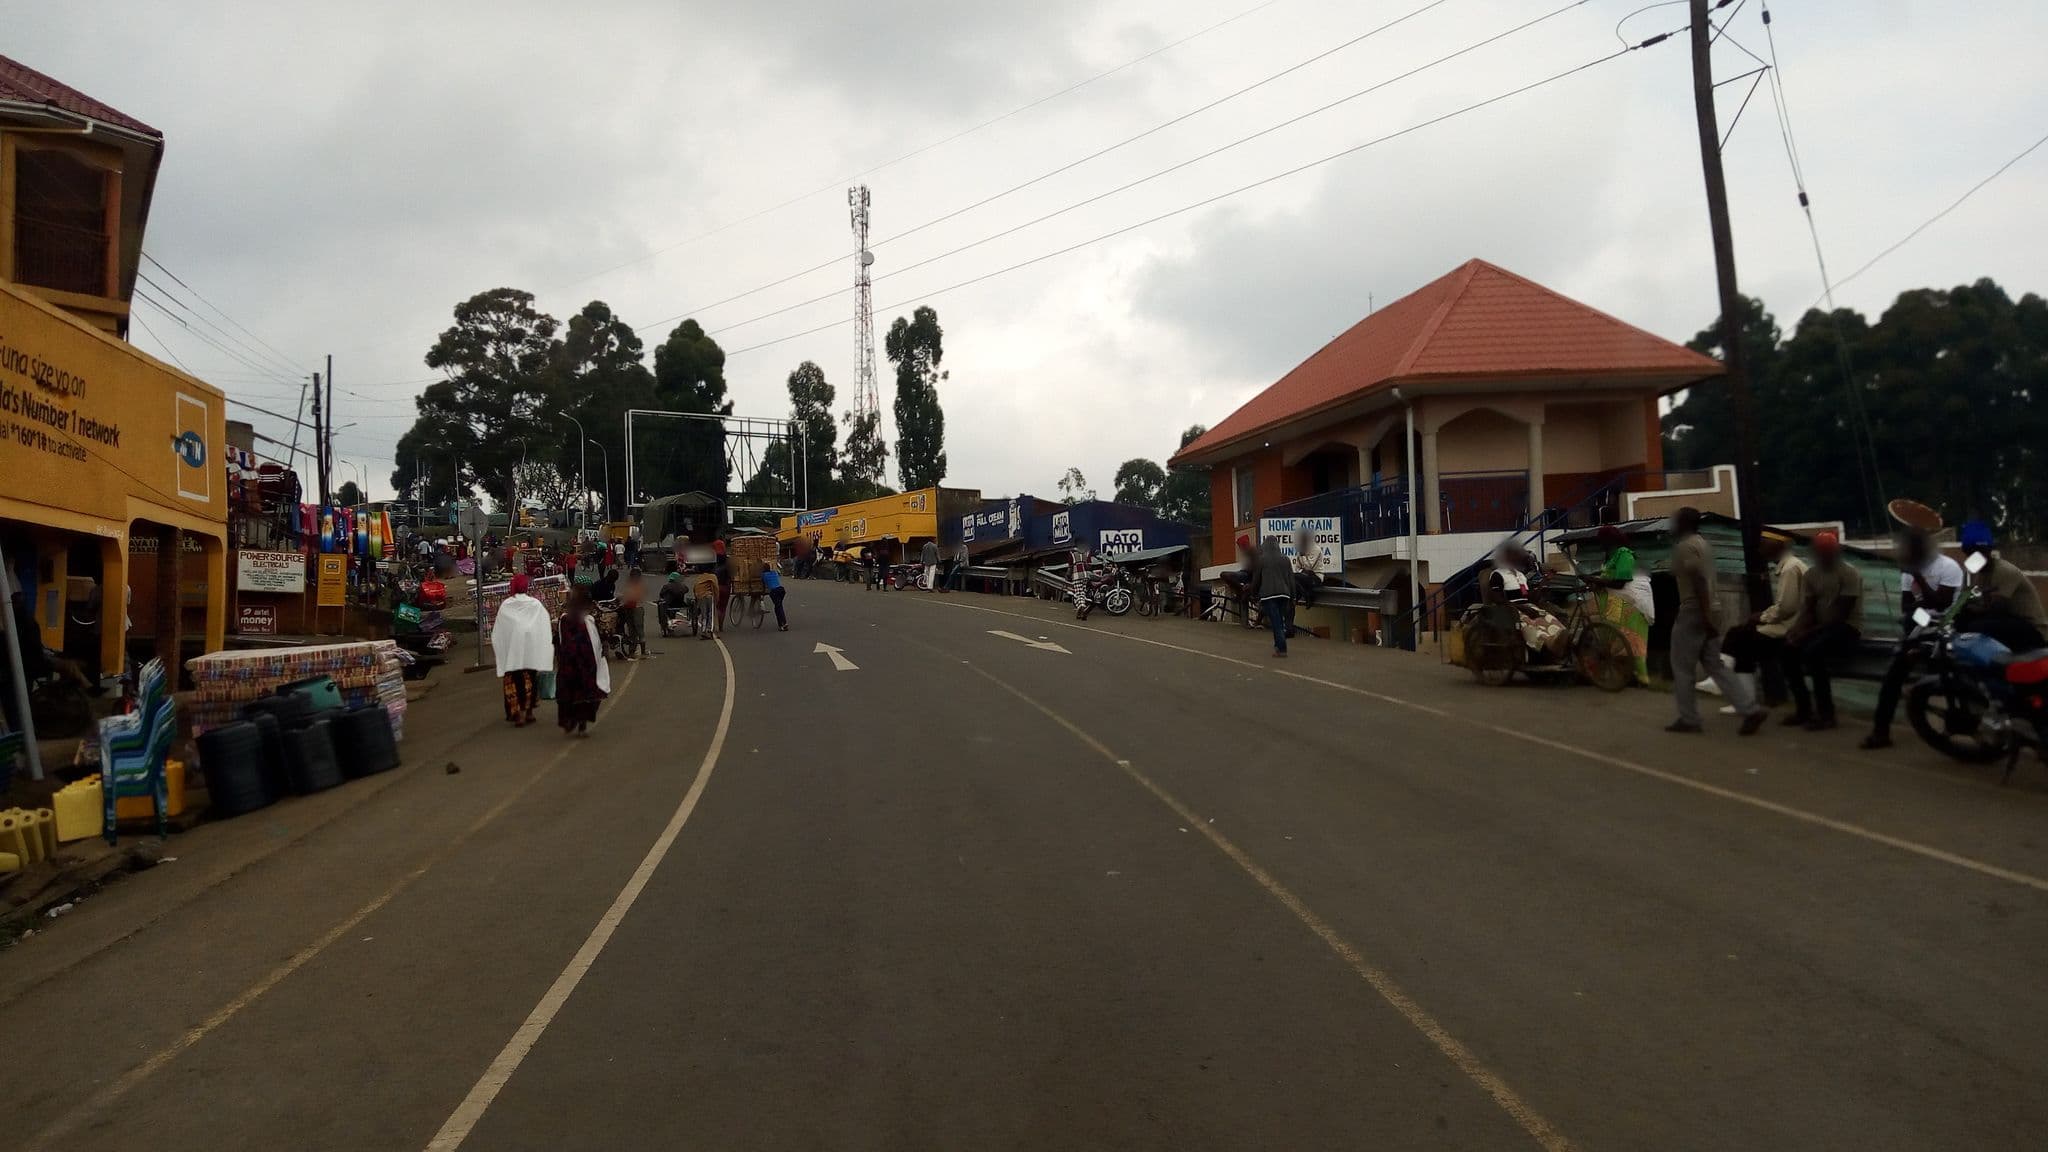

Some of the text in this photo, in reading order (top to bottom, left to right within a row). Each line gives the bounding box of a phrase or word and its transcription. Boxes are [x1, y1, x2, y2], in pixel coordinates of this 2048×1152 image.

[0, 346, 85, 400] una size yo on
[0, 380, 120, 448] a's Number 1 network
[57, 441, 87, 463] activate
[1268, 520, 1332, 531] HOME AGAIN
[1104, 534, 1139, 545] LATO
[1315, 535, 1340, 543] ODGE
[240, 552, 304, 562] POWER SOURCE
[252, 561, 289, 569] ELECTRICALS
[240, 616, 274, 627] money
